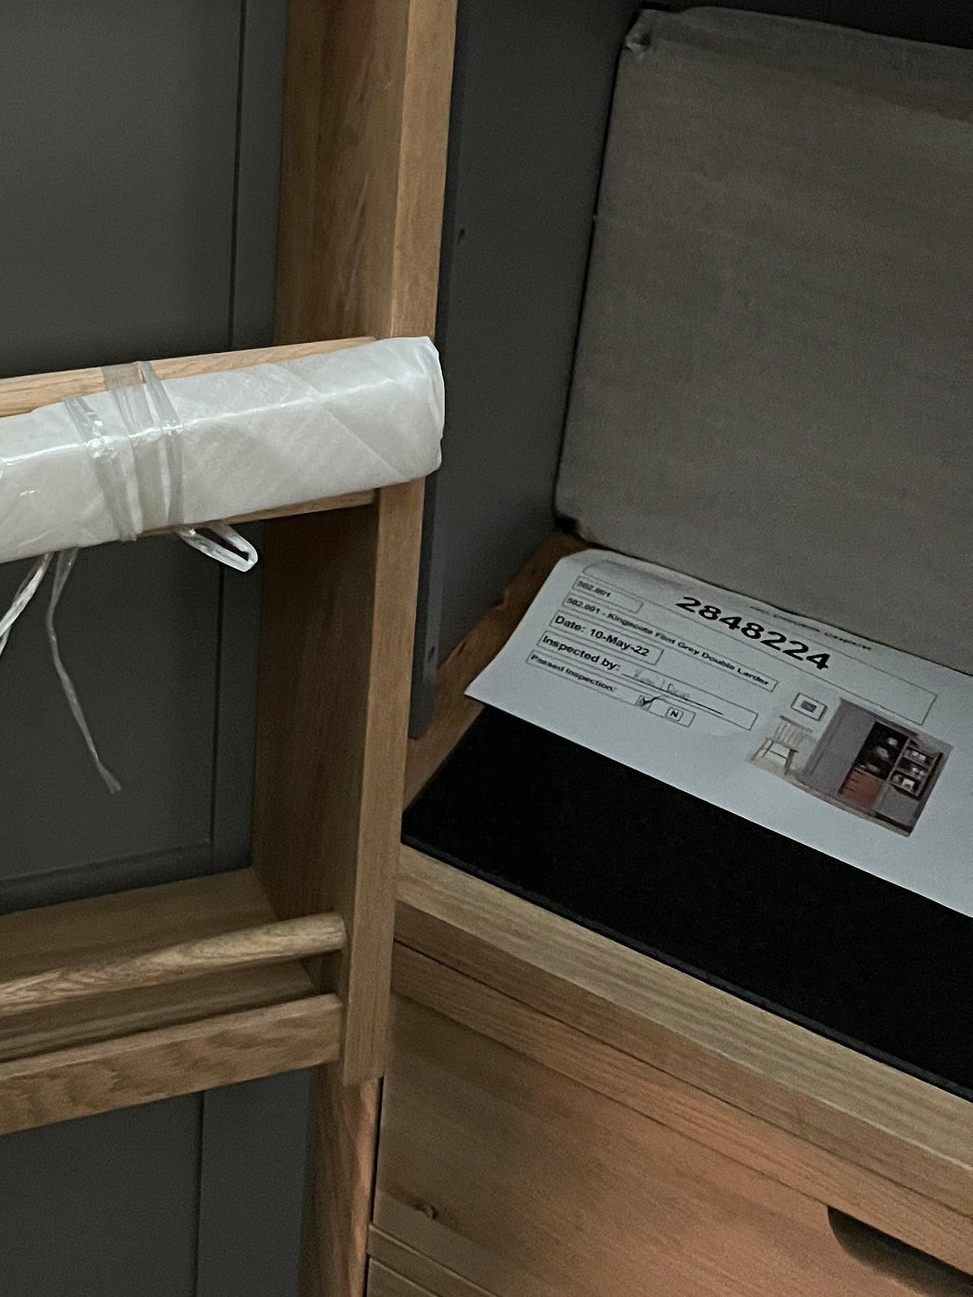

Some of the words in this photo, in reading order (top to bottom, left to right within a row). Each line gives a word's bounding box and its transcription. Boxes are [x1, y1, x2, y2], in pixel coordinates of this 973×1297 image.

[554, 615, 586, 633] Date:
[590, 628, 650, 657] 10-May-22
[675, 596, 831, 670] 2848224
[530, 654, 565, 672] Passed
[565, 668, 618, 693] Inspection:
[542, 635, 600, 664] Inspected
[601, 658, 622, 672] by:
[677, 641, 700, 655] Grey
[701, 651, 735, 671] Double
[737, 667, 769, 686] Larder
[670, 710, 679, 718] N
